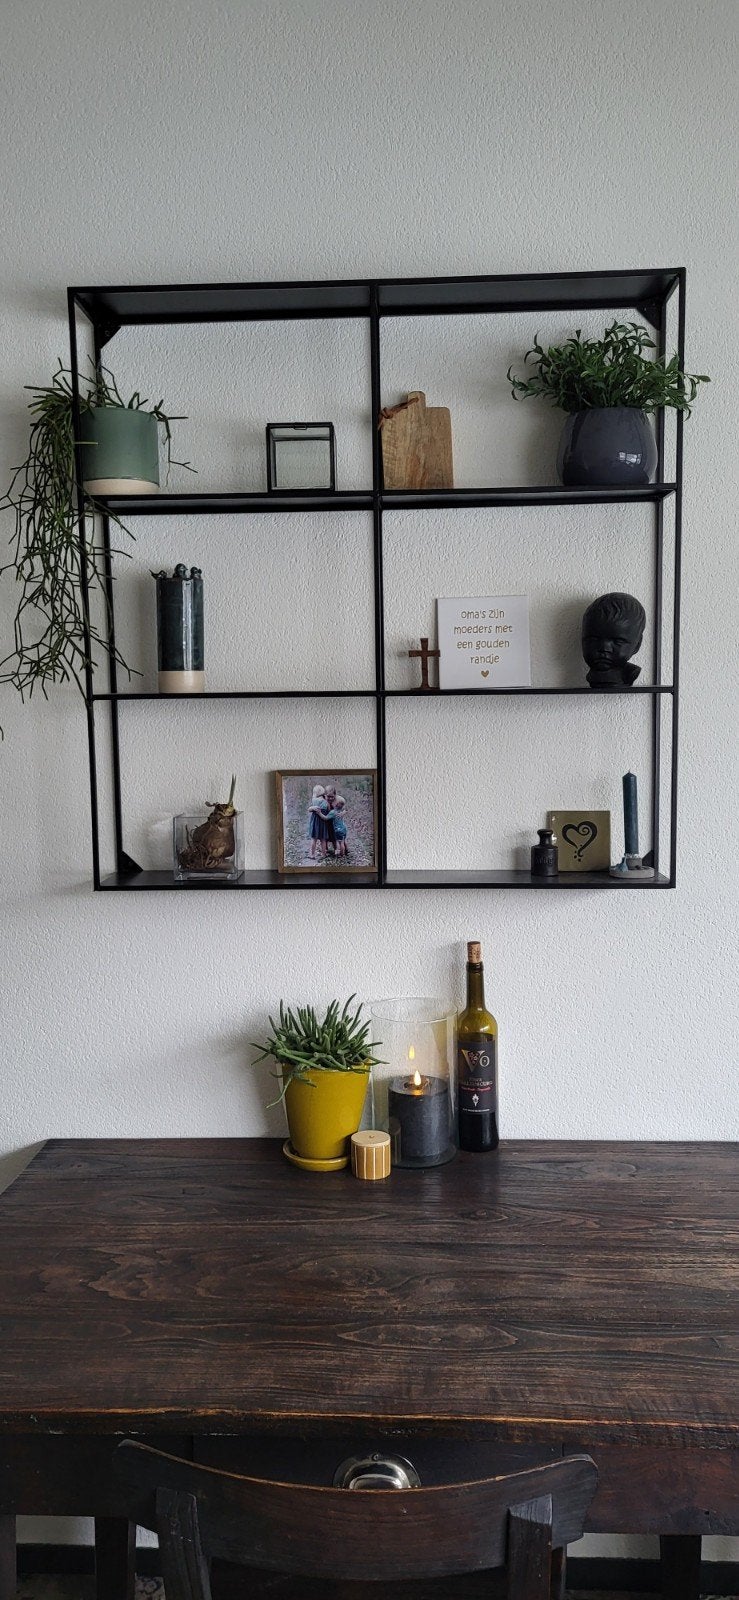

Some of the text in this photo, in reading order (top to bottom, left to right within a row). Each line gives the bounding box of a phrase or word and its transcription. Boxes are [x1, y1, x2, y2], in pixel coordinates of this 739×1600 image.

[461, 609, 505, 619] oma's zijn
[453, 624, 513, 635] moeders met
[456, 639, 510, 650] een gouden
[470, 653, 500, 665] randje
